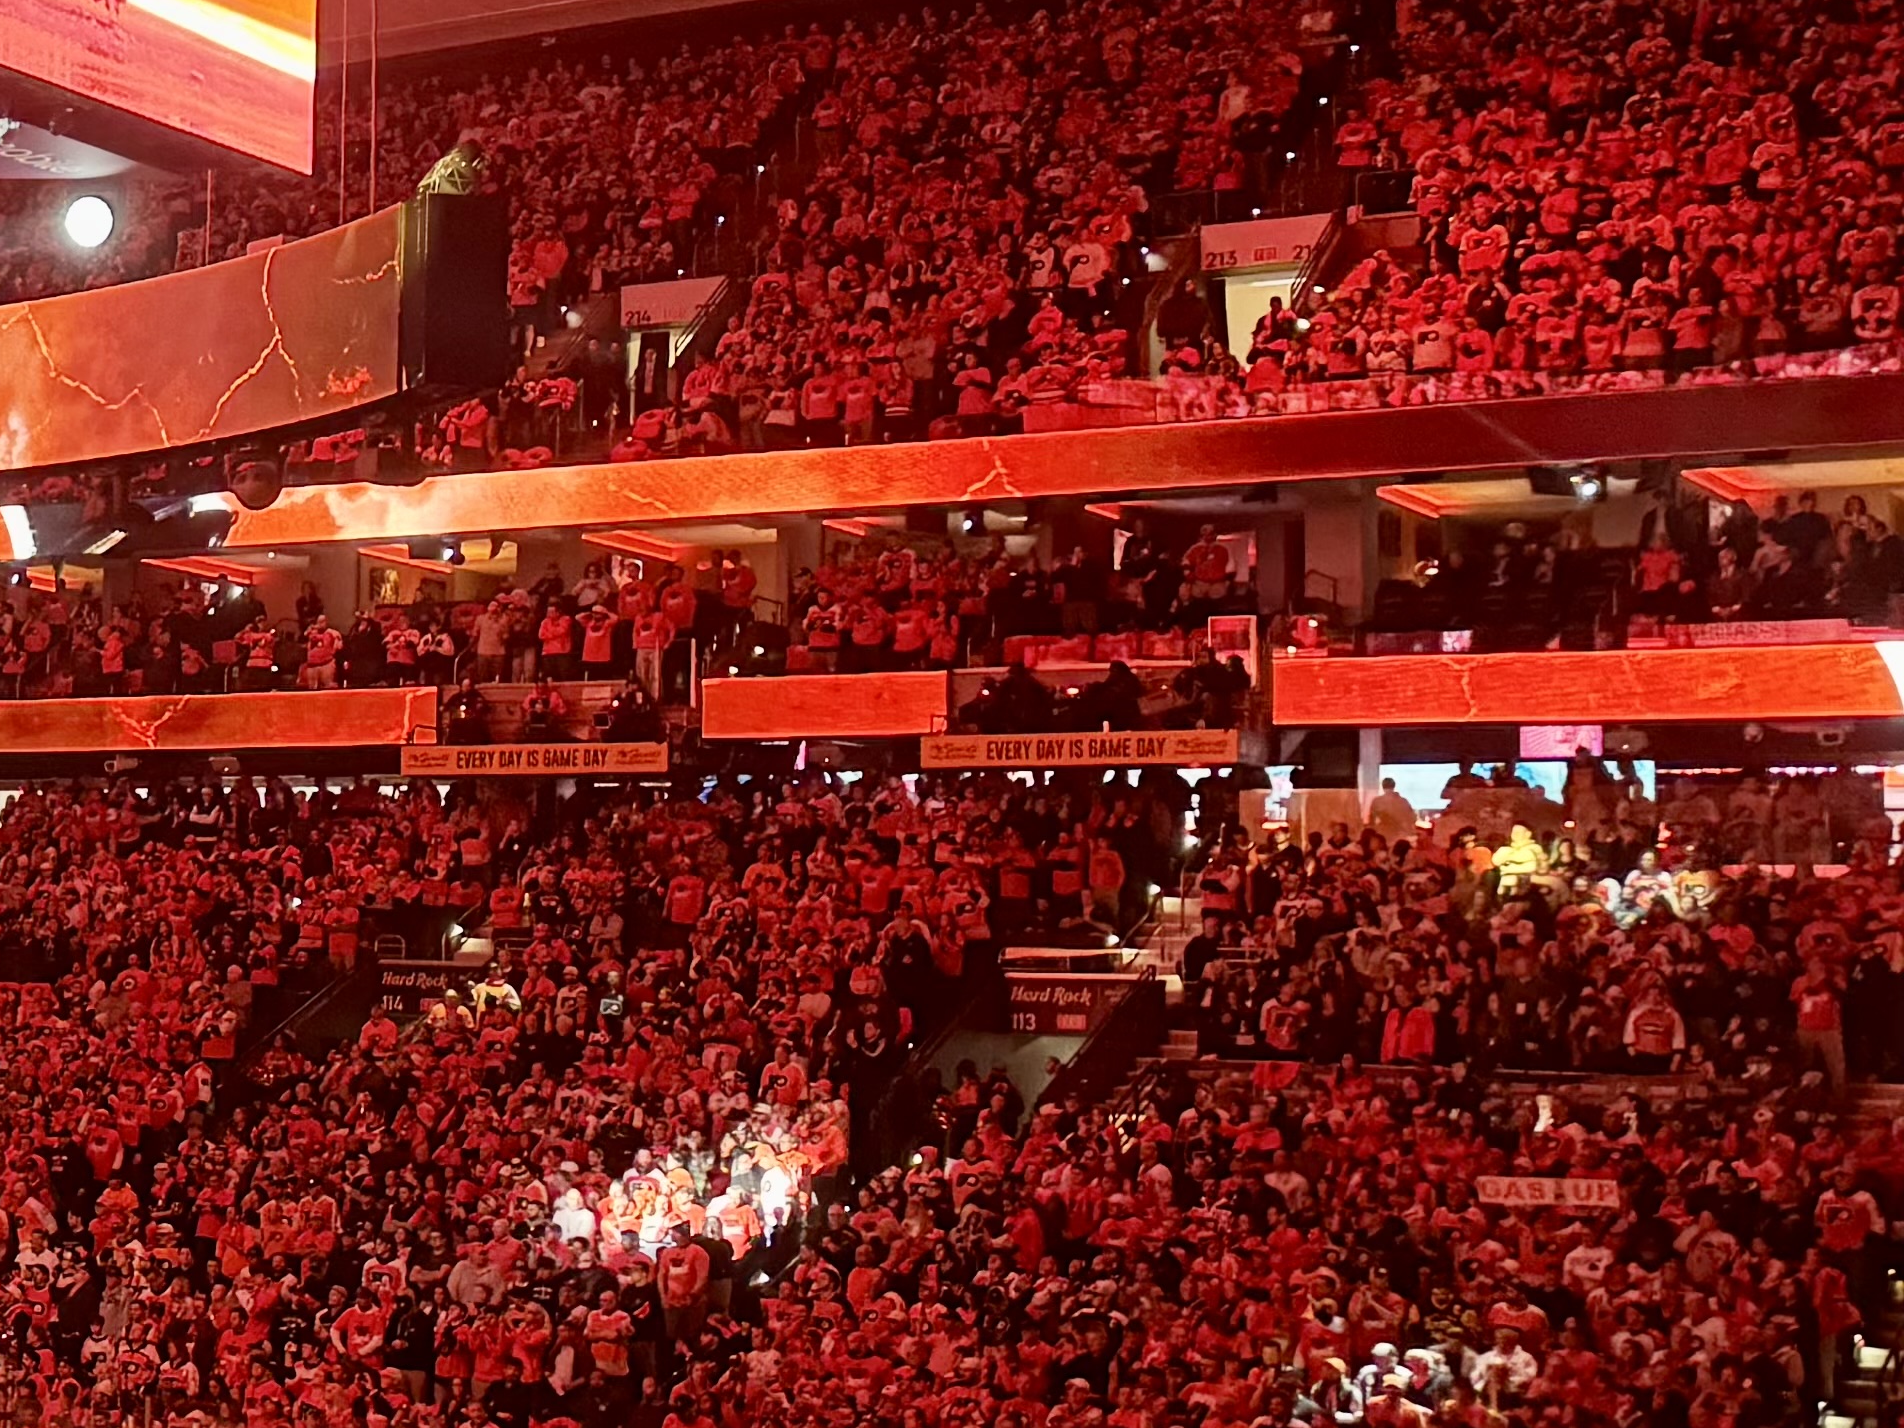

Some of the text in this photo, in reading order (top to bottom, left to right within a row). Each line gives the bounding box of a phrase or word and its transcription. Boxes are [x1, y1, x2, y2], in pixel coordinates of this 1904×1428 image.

[457, 750, 495, 769] EVERY
[499, 750, 523, 768] DAY
[527, 749, 539, 767] IS
[543, 748, 579, 767] GAME
[583, 748, 609, 767] DAY
[986, 740, 1032, 761] EVERY
[1036, 739, 1065, 760] DAY
[1069, 739, 1084, 759] IS
[1088, 738, 1134, 758] GAME
[1137, 737, 1167, 757] DAY
[382, 971, 448, 989] Hard Rock
[381, 995, 404, 1011] 114
[1010, 986, 1092, 1006] Hard Rock
[1011, 1012, 1036, 1031] 113
